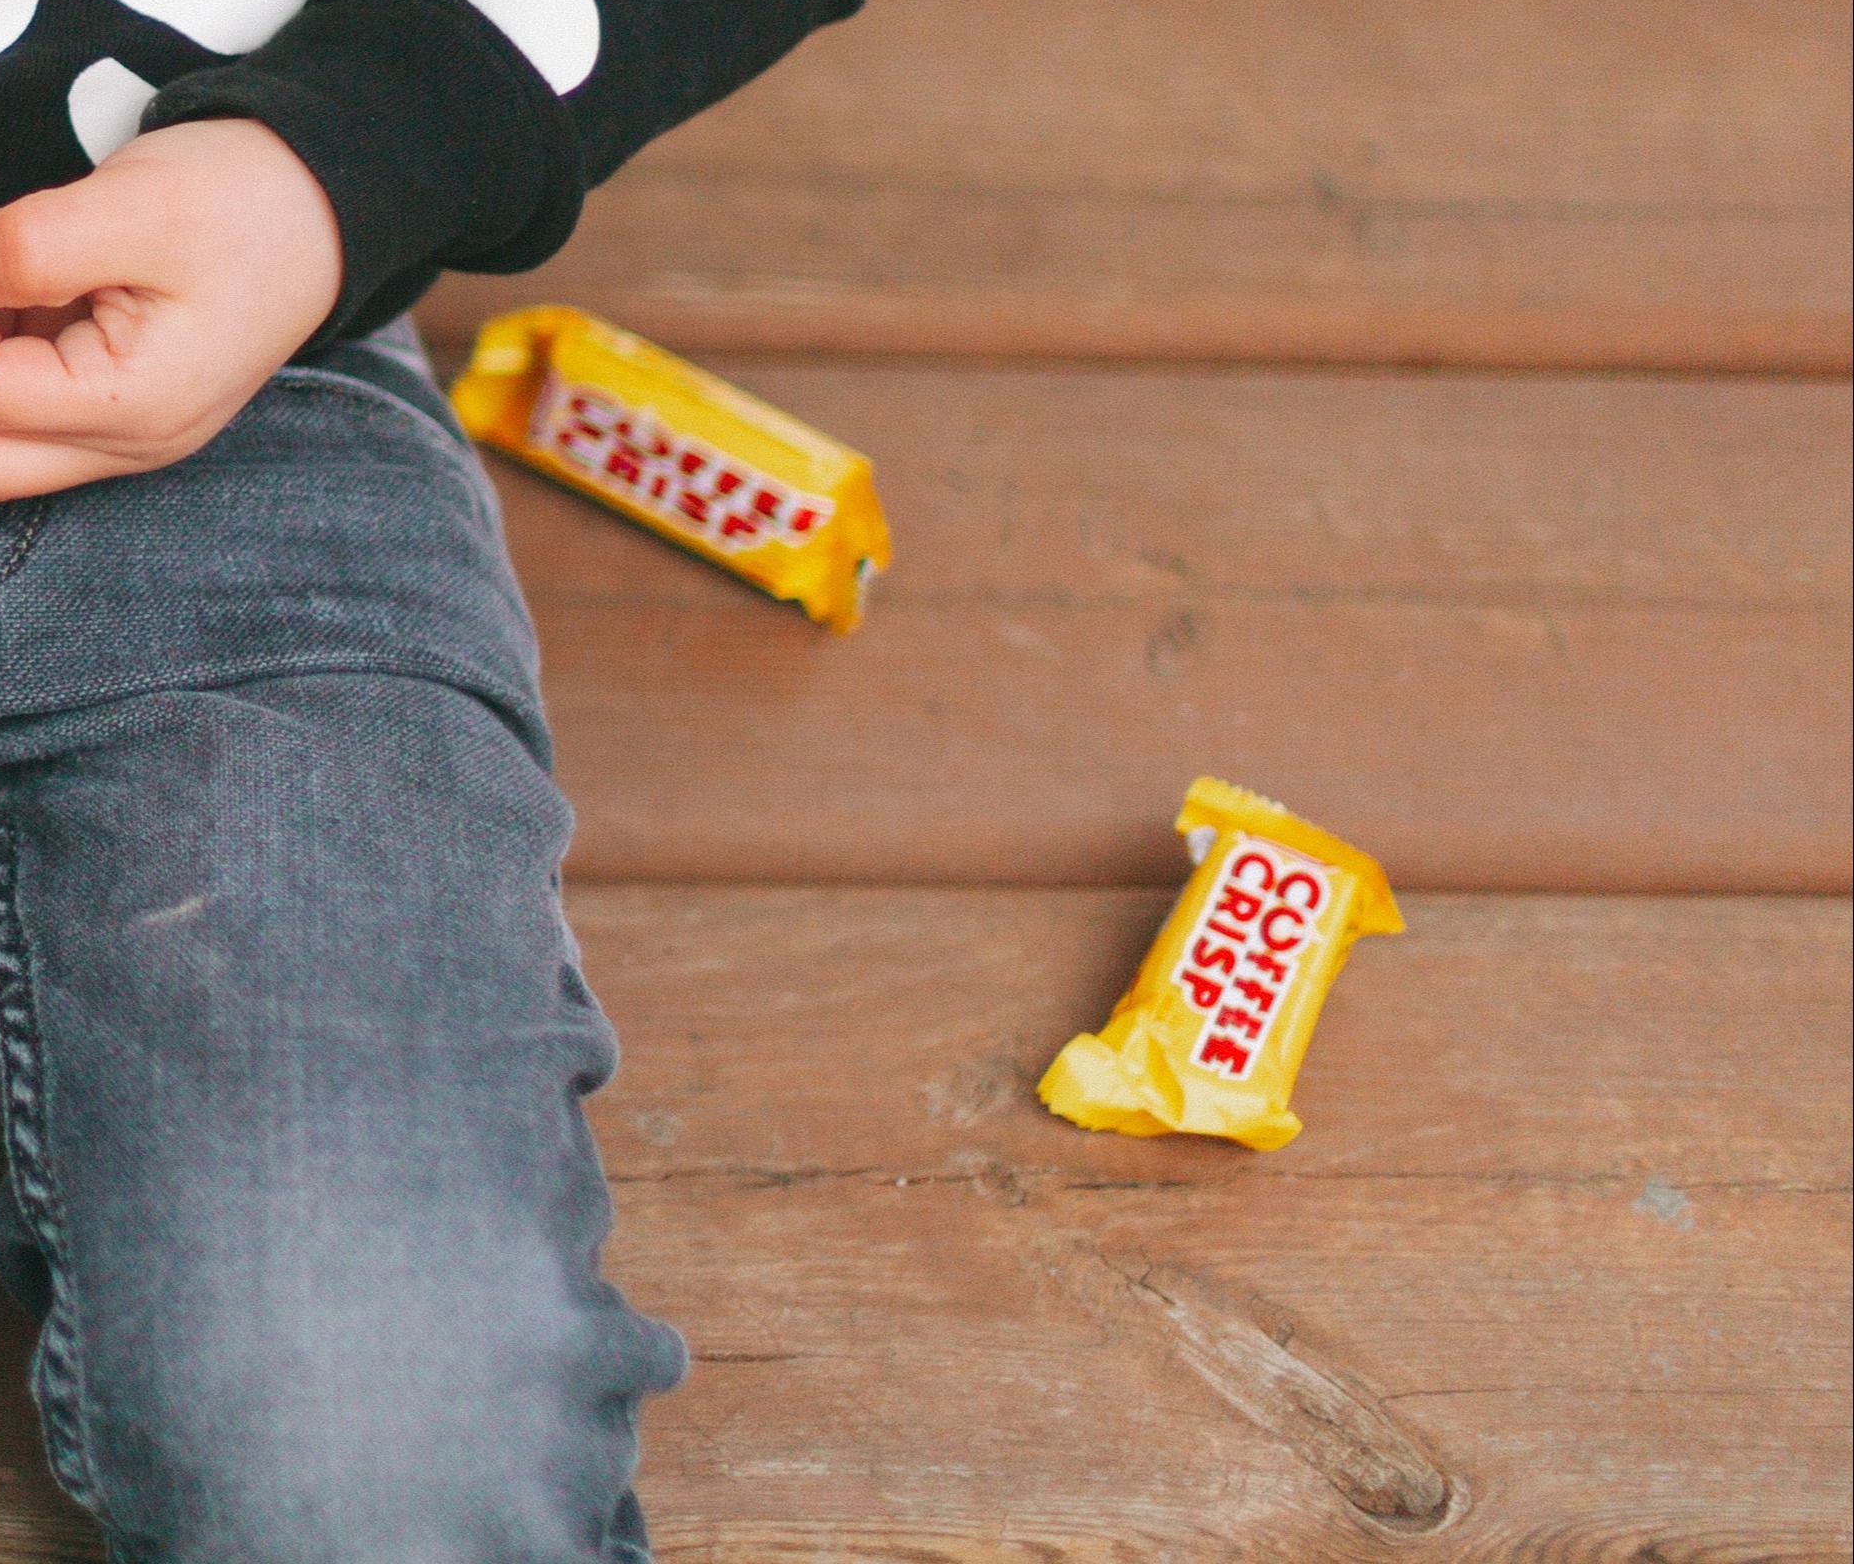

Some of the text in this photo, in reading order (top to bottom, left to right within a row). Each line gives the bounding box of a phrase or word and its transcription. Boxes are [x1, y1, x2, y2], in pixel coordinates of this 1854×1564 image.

[558, 430, 757, 539] CRISP
[1180, 852, 1276, 1010] CRISP
[1199, 872, 1321, 1075] COFFEE
